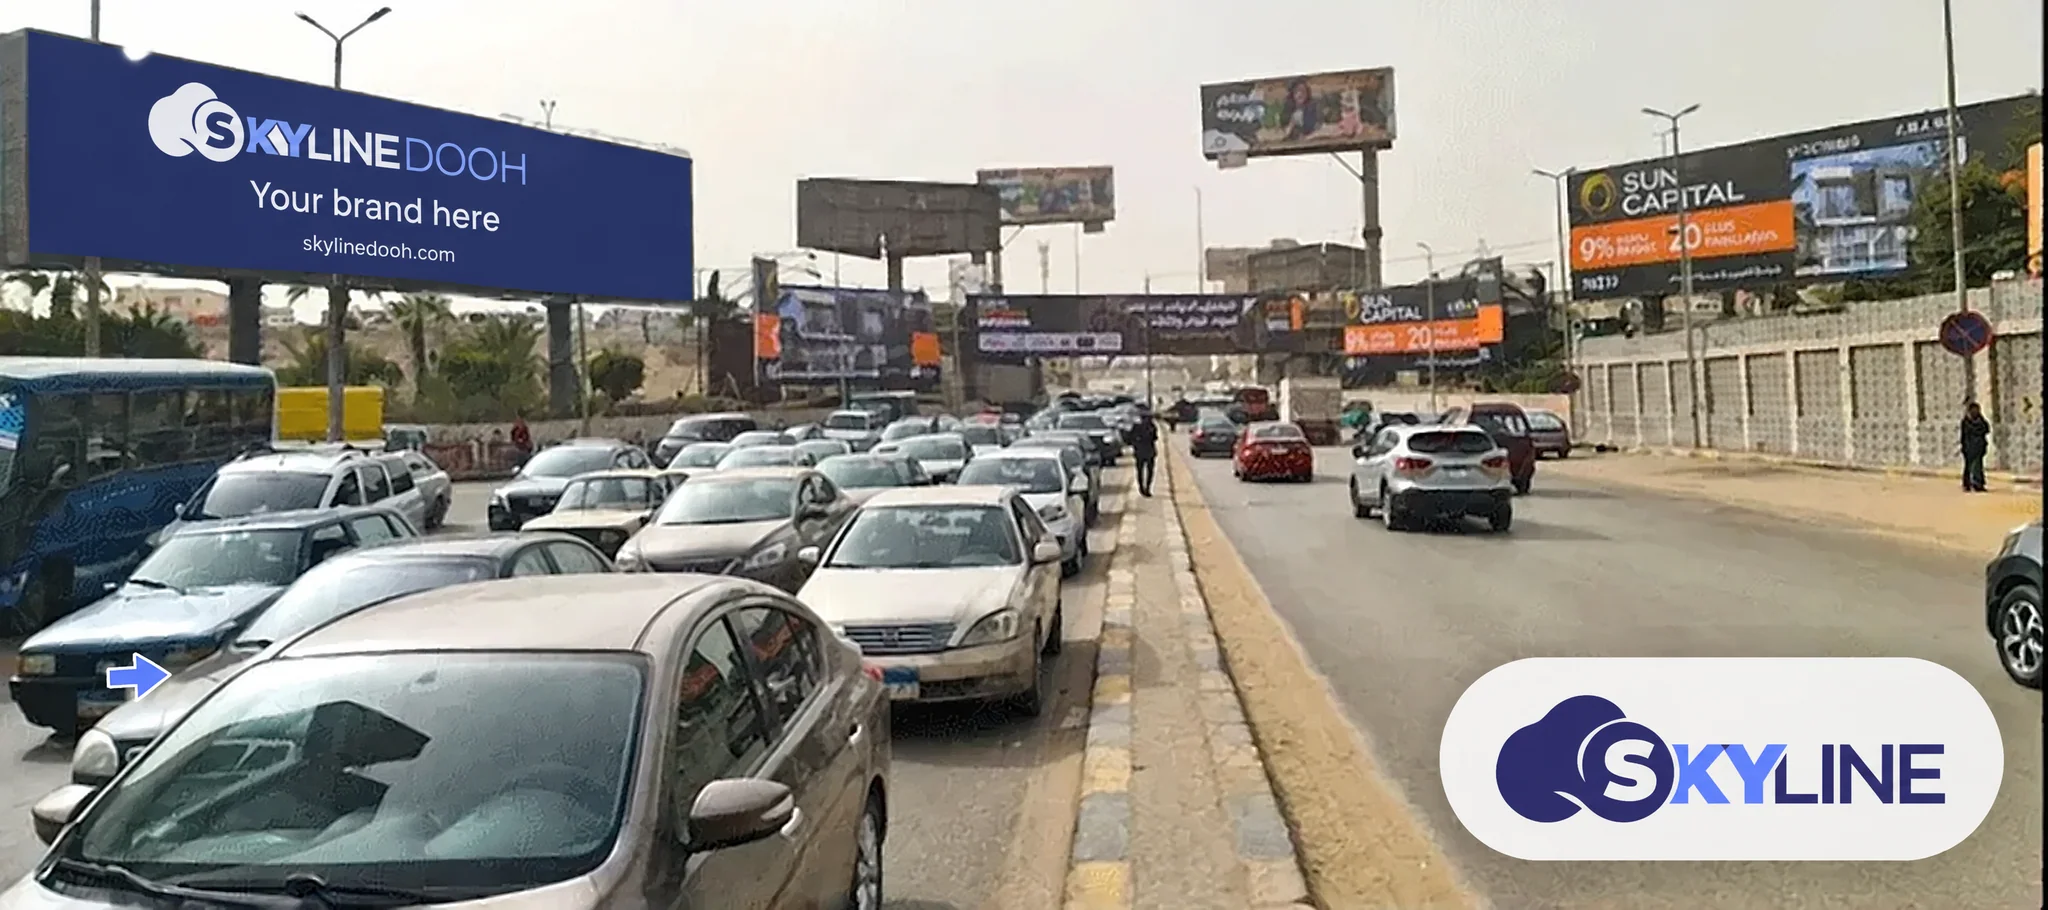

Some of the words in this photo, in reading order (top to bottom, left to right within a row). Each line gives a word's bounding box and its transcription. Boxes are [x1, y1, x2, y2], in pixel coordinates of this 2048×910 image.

[1622, 168, 1679, 193] SUN
[250, 179, 324, 214] Your
[333, 187, 422, 225] brand
[433, 199, 501, 232] here
[1621, 180, 1746, 216] CAPITAL
[303, 234, 456, 263] skylinedooh.com
[1360, 305, 1422, 324] CAPITAL
[1406, 325, 1432, 350] 20
